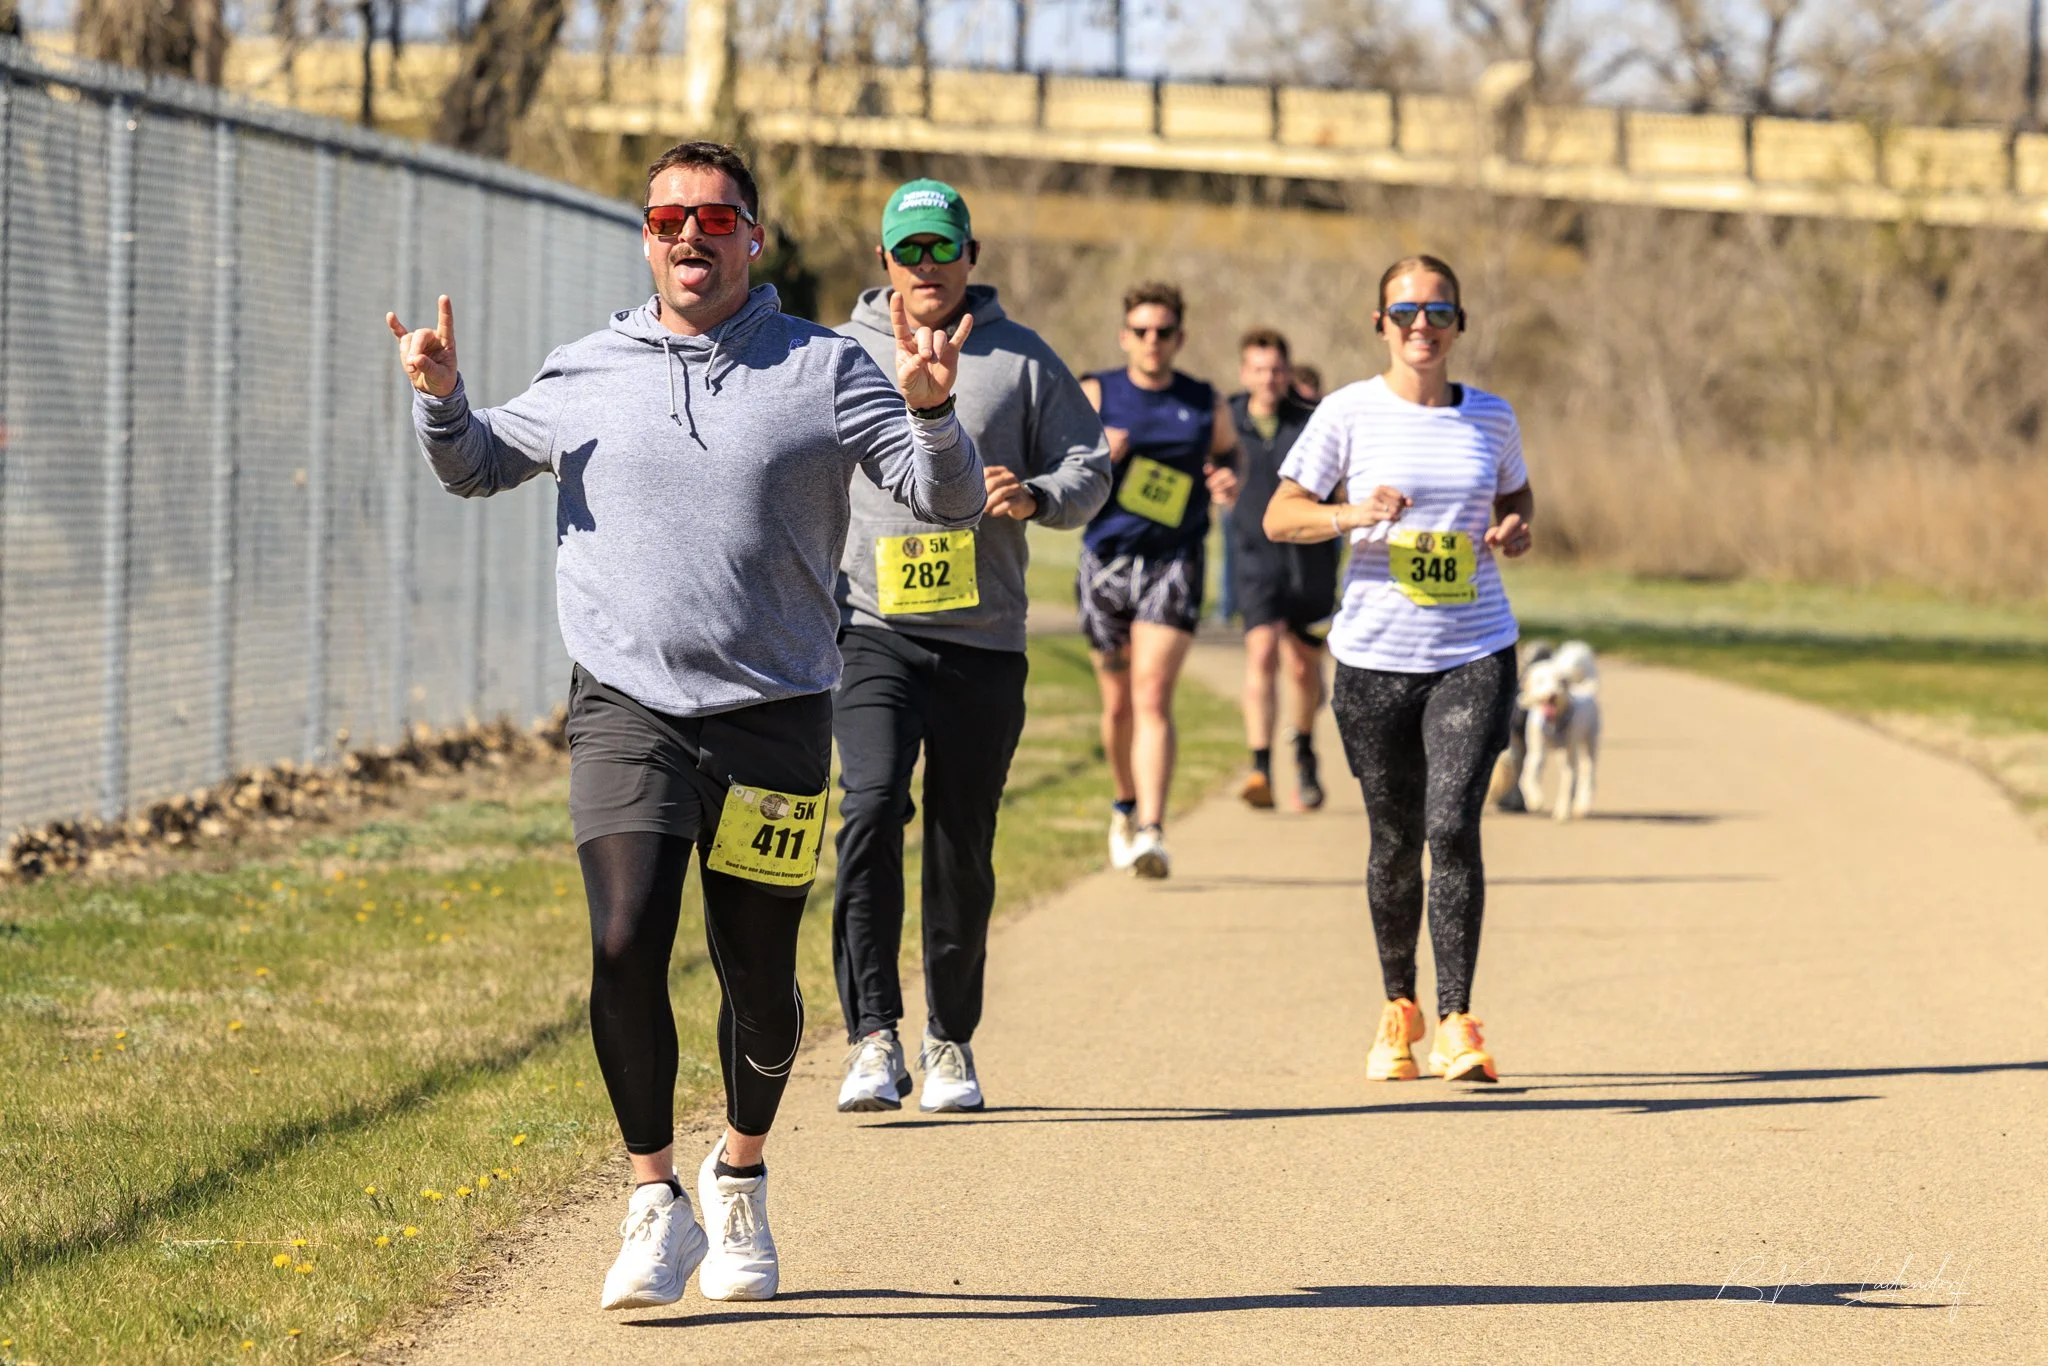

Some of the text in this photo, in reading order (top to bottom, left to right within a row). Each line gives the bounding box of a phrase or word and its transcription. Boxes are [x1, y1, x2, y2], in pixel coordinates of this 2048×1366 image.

[929, 537, 950, 553] 5K
[1441, 535, 1457, 550] 5K
[901, 560, 951, 589] 282
[1411, 556, 1457, 583] 348
[794, 801, 817, 820] 5K
[751, 823, 806, 860] 411
[725, 860, 739, 869] Good
